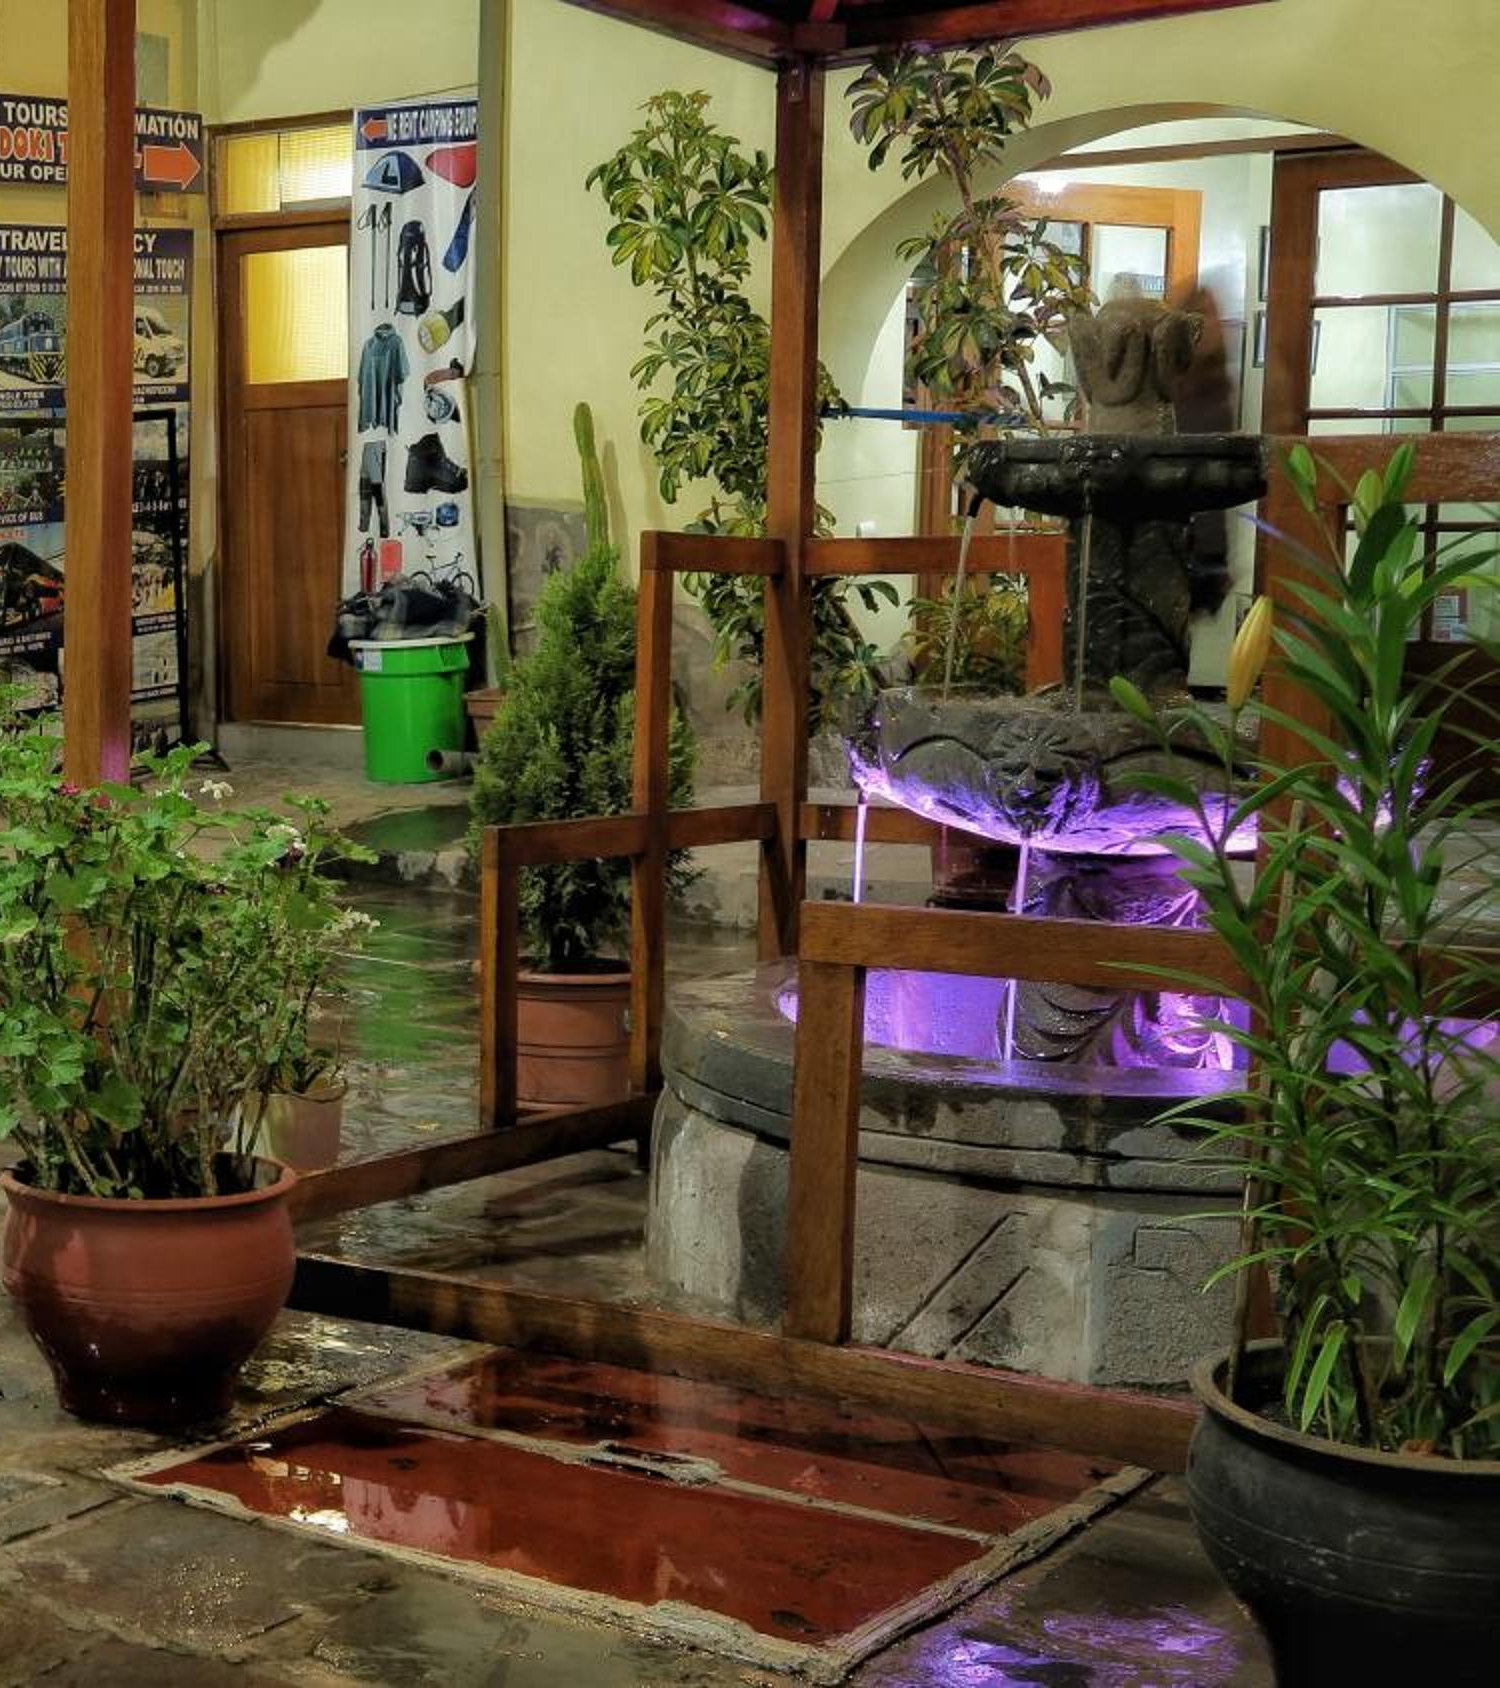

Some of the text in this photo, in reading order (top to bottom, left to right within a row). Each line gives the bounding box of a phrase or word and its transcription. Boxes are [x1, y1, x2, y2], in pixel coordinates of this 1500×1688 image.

[3, 101, 68, 127] TOURS
[133, 114, 199, 139] MATIÓN
[454, 106, 477, 136] EQUIP
[4, 256, 37, 279] TOURS
[38, 257, 61, 279] WITH
[156, 258, 185, 280] TOUCH
[18, 513, 27, 522] OF
